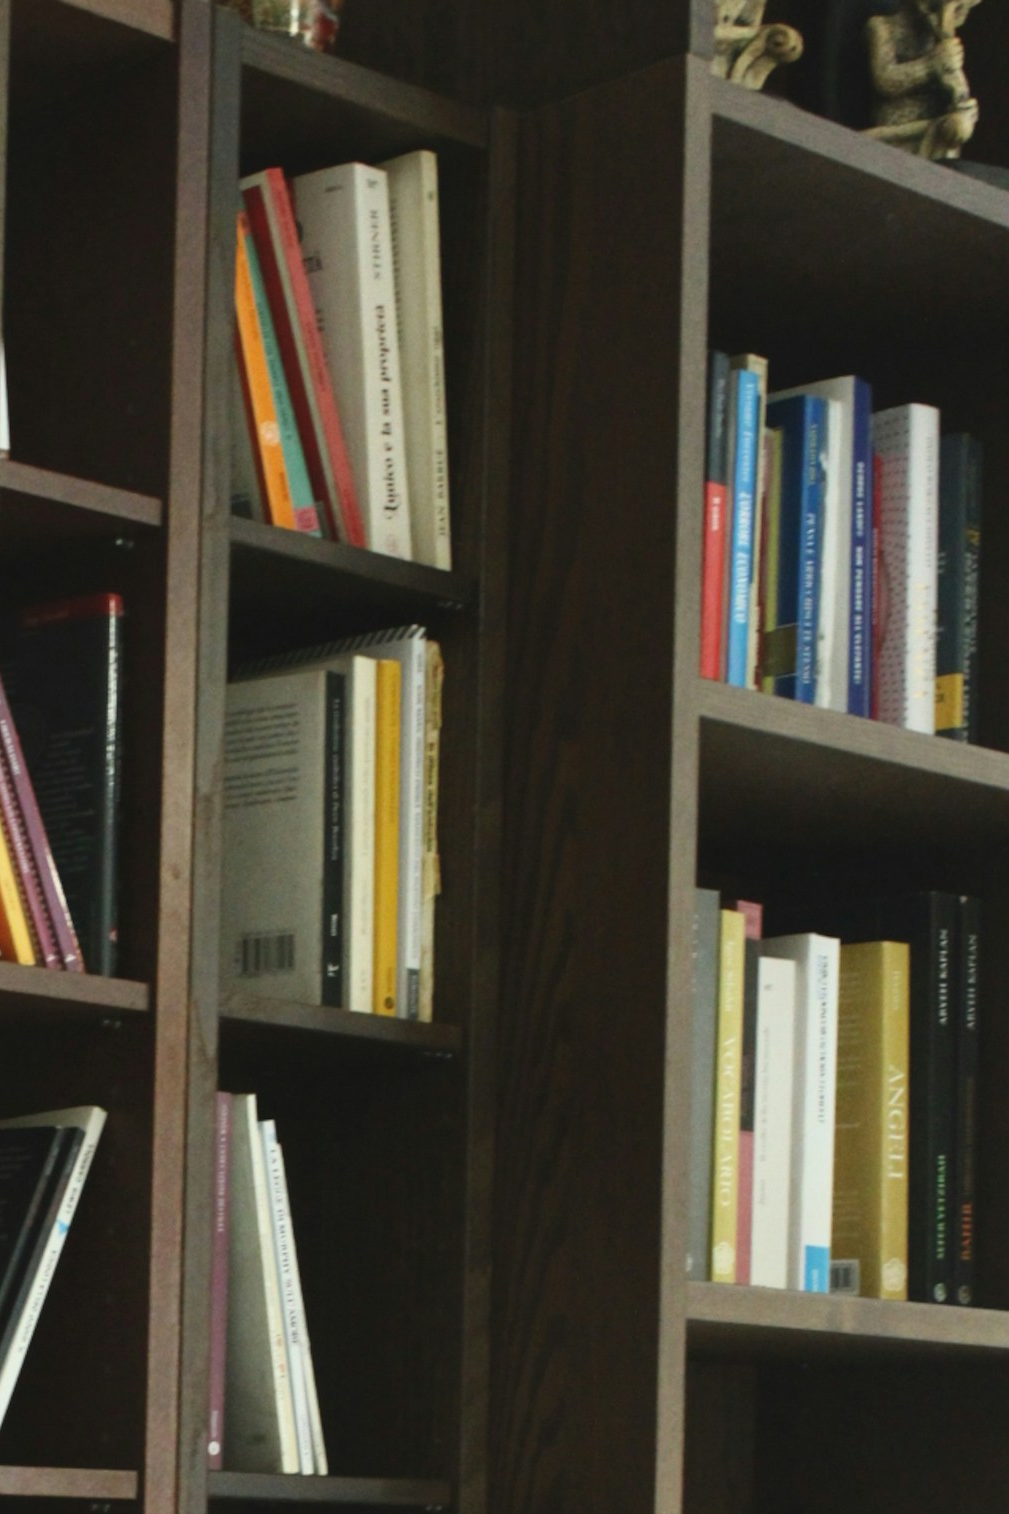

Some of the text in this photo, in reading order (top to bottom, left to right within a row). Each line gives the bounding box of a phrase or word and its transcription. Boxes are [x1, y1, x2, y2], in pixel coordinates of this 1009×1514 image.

[367, 208, 382, 281] STIRNER
[372, 303, 391, 383] proprietà
[379, 387, 390, 416] sua
[937, 927, 949, 1026] ARYEH KAPLAN
[964, 933, 978, 1032] ARYEH KAPLAN
[717, 1037, 737, 1207] VOCABOLARIO
[885, 1063, 906, 1180] ANGELI
[935, 1153, 946, 1259] SEFER YETZIRAH
[959, 1201, 973, 1260] BAHIR
